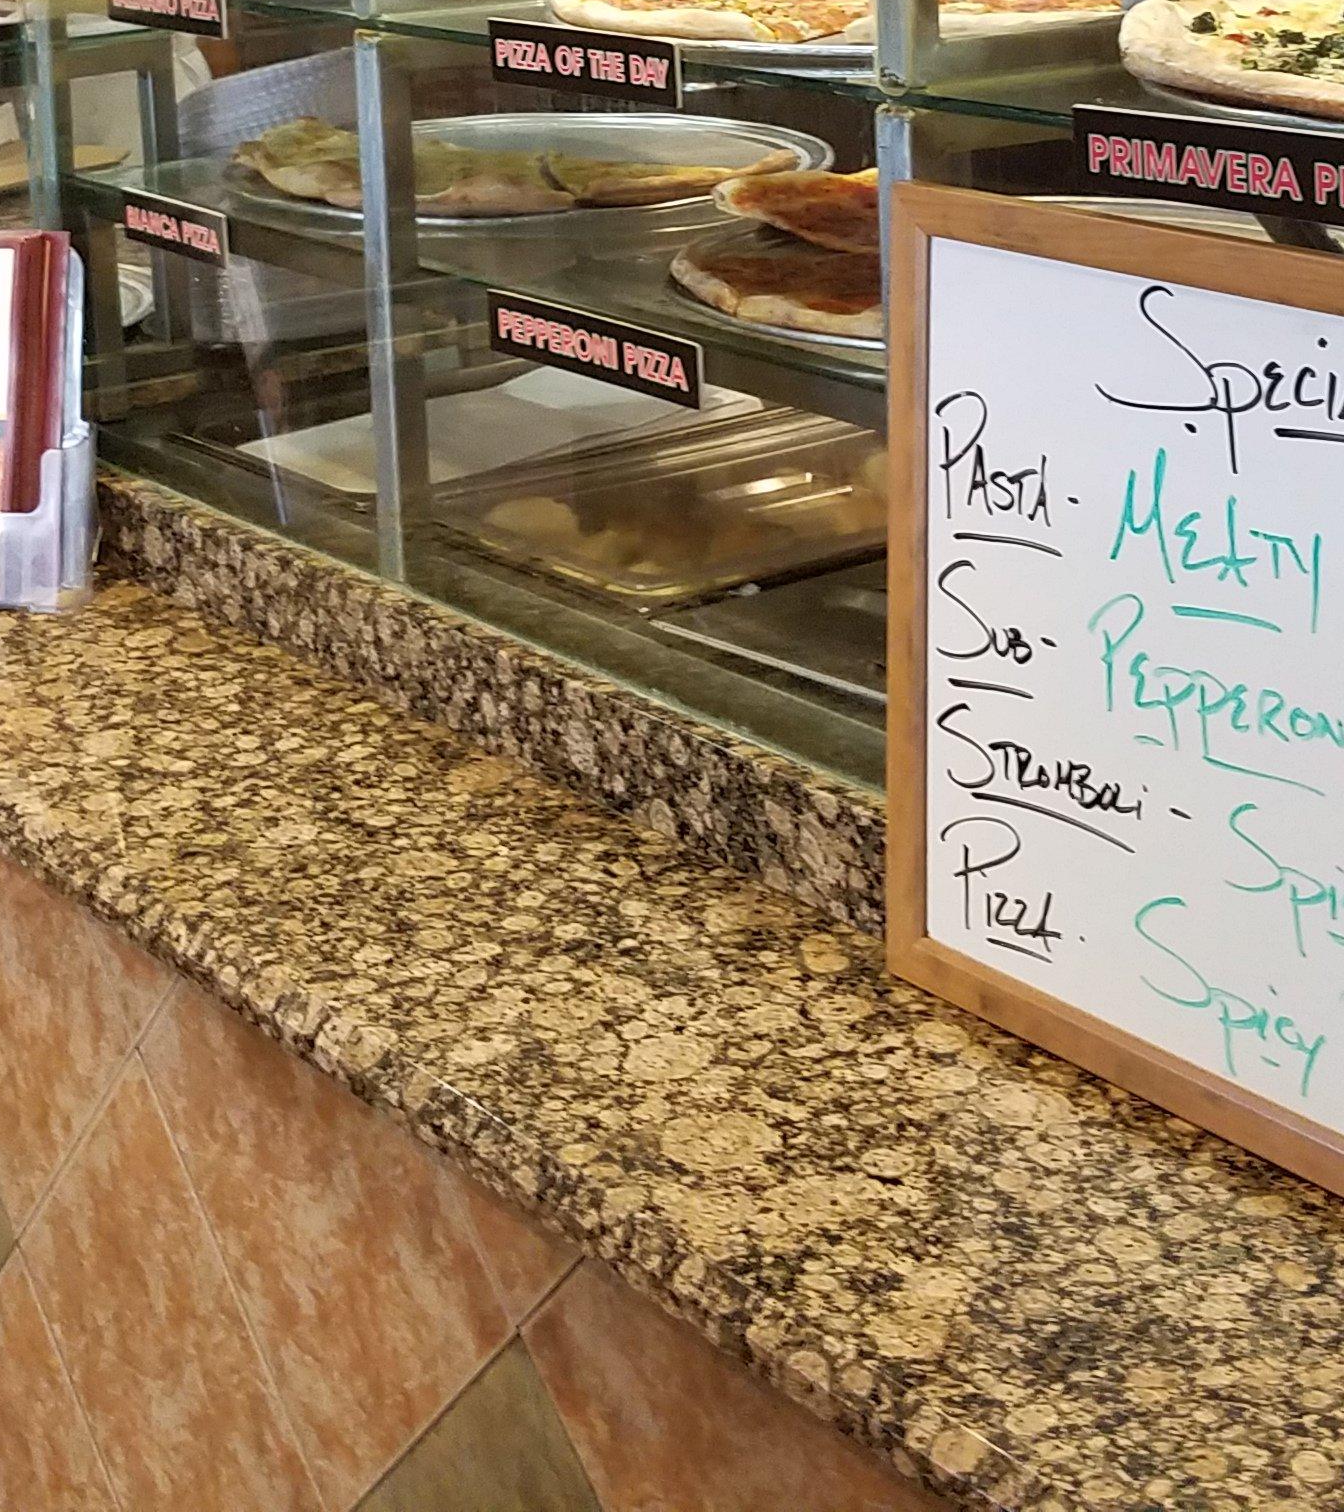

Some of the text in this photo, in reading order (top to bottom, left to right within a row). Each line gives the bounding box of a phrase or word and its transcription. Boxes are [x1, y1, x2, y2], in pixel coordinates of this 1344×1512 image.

[494, 38, 670, 89] PIZZA OF THE DAY
[1087, 132, 1303, 202] PRIMAVERA
[181, 219, 222, 255] PIZZA
[497, 307, 690, 393] PEPPERONI PIZZA
